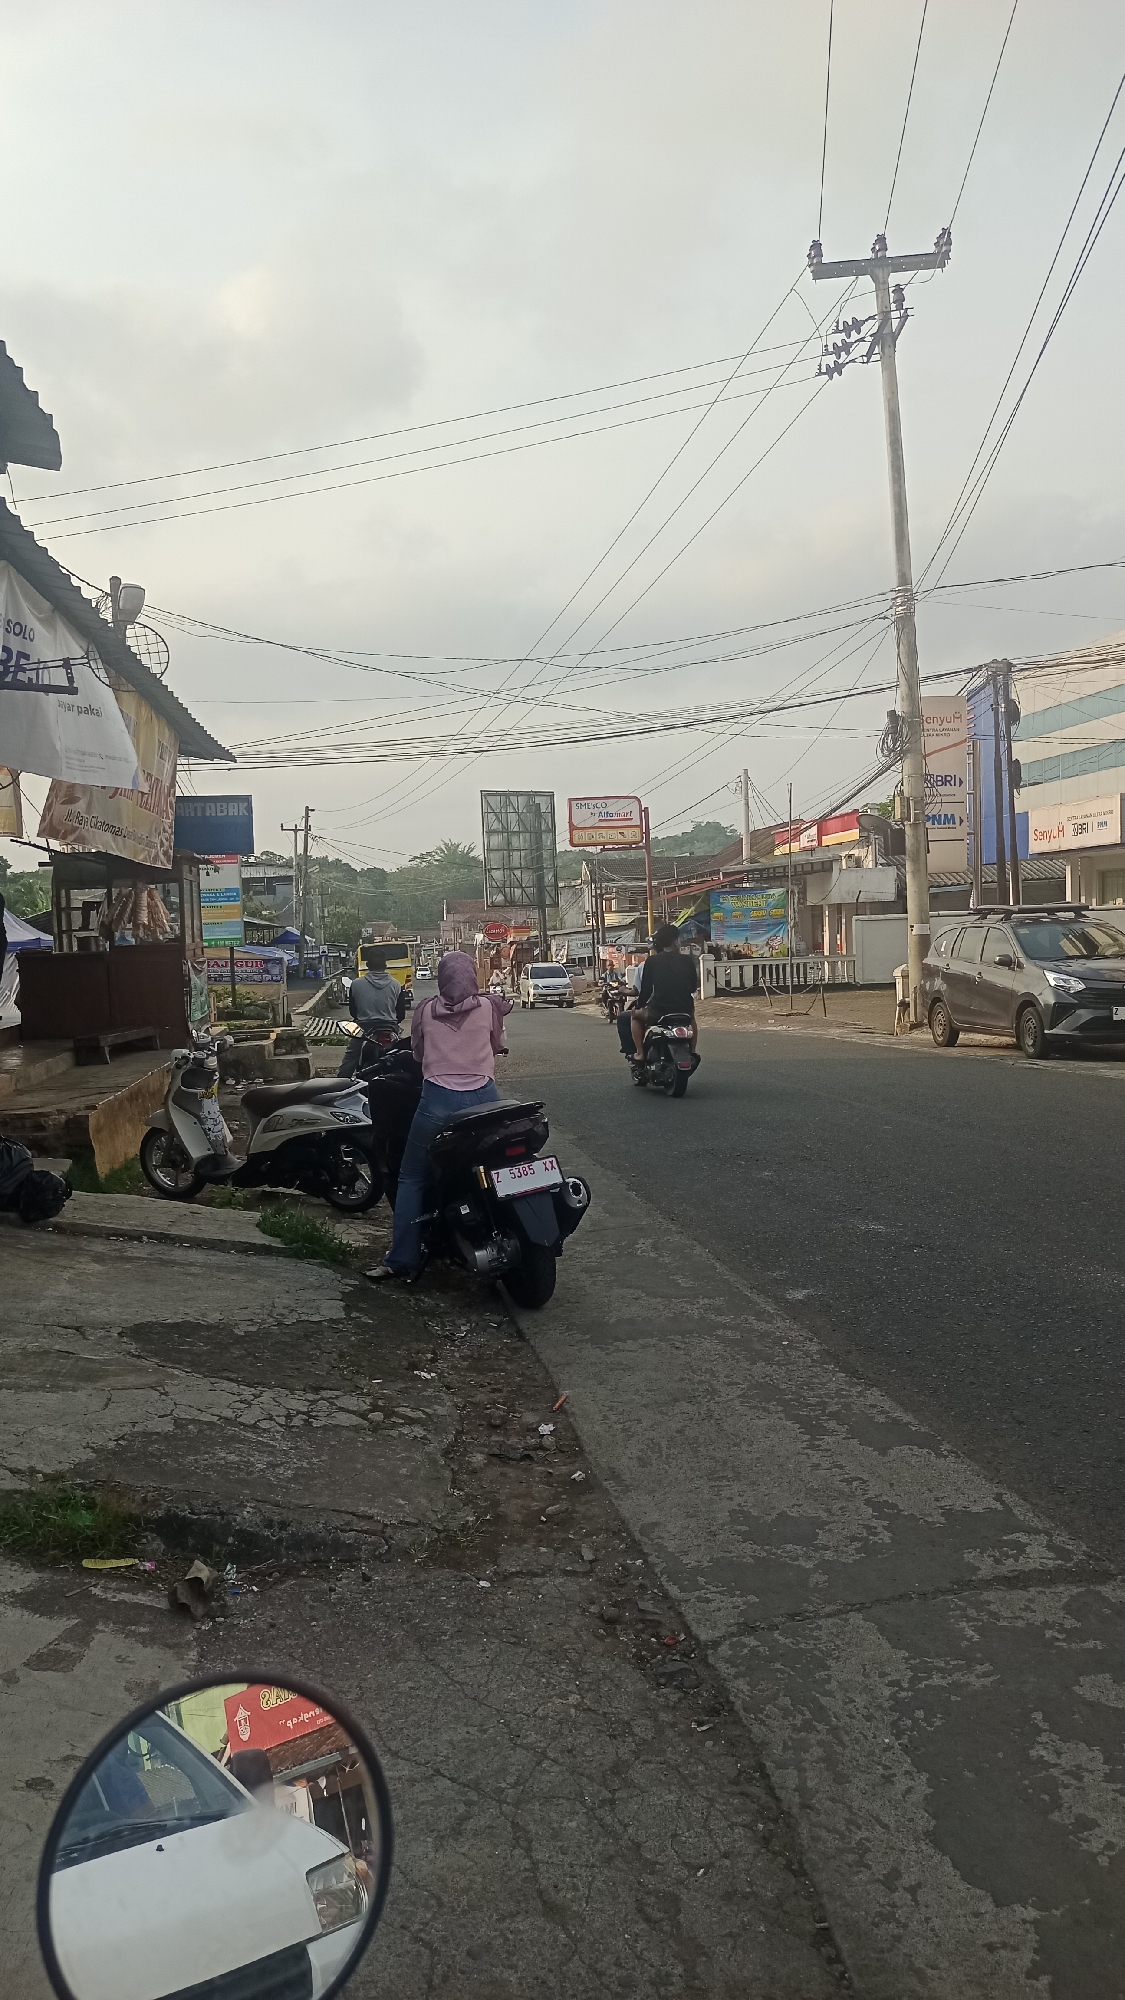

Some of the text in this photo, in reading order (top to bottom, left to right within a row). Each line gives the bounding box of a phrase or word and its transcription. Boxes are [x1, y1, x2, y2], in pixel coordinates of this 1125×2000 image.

[5, 619, 35, 642] SOLO
[76, 704, 103, 717] pakai
[174, 802, 249, 817] ARTABAK
[90, 815, 124, 839] Cikatomas
[494, 1159, 556, 1184] Z 5385 XX
